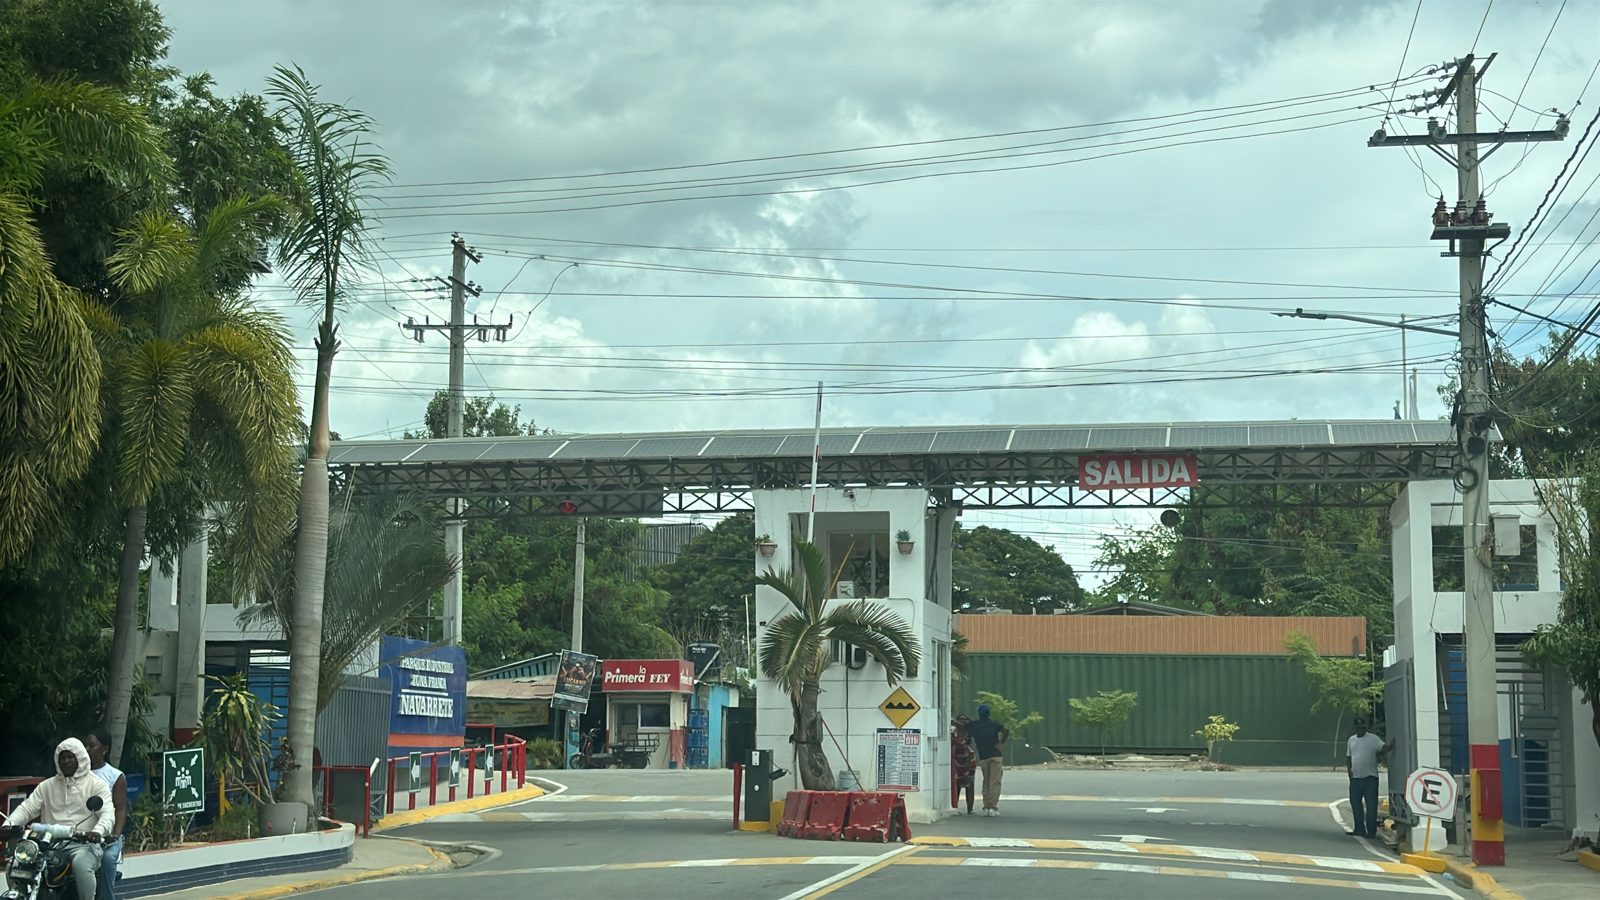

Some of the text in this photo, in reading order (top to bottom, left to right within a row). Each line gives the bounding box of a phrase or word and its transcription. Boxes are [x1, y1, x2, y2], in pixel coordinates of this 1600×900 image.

[1084, 458, 1191, 486] SALIDA
[401, 657, 454, 674] PARQUE INDUSTRIAL
[605, 668, 646, 683] Primera
[411, 674, 447, 689] ZONA FRANCA
[399, 694, 454, 718] NAVARRETE
[1421, 779, 1442, 805] E
